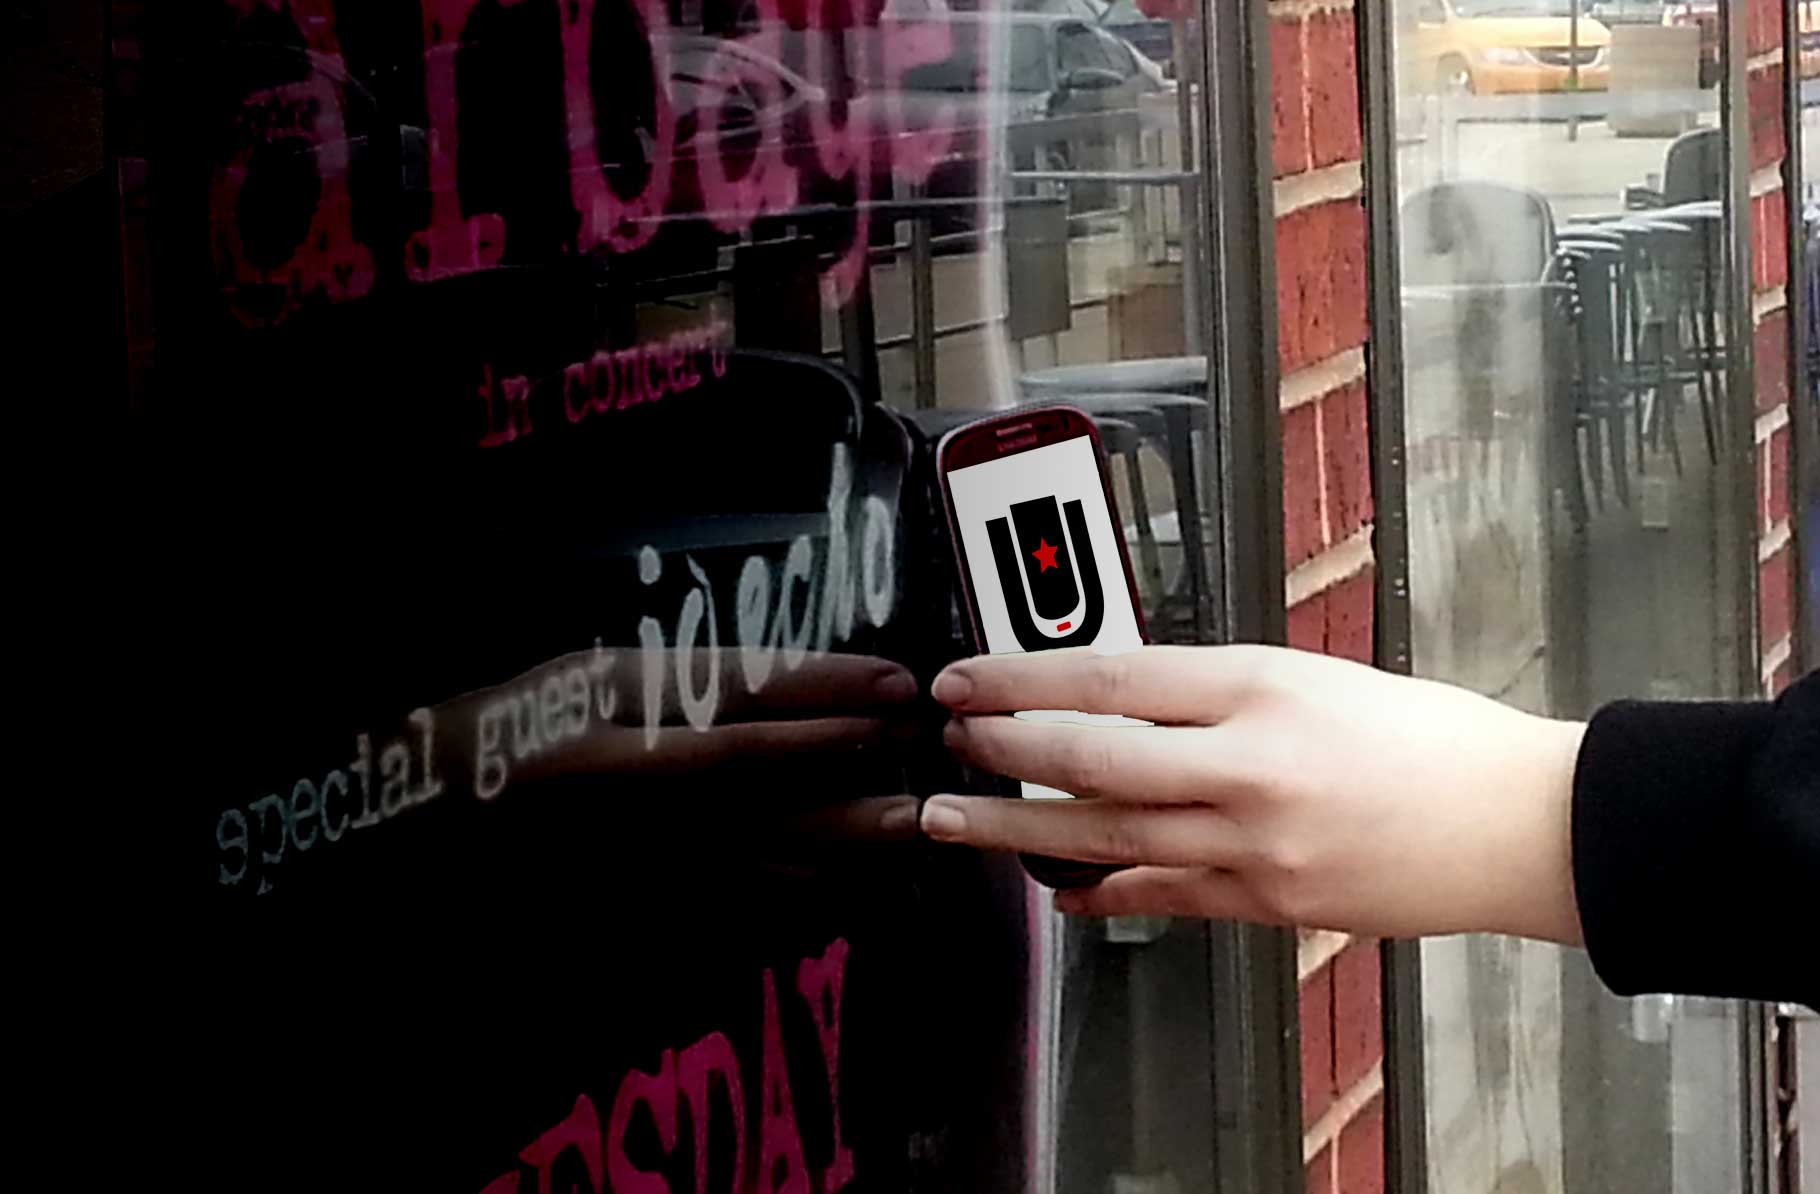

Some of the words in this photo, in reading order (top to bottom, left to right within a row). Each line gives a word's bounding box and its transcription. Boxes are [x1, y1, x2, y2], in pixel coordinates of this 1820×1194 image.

[561, 308, 732, 425] concert
[215, 706, 448, 897] special
[472, 636, 617, 802] guest
